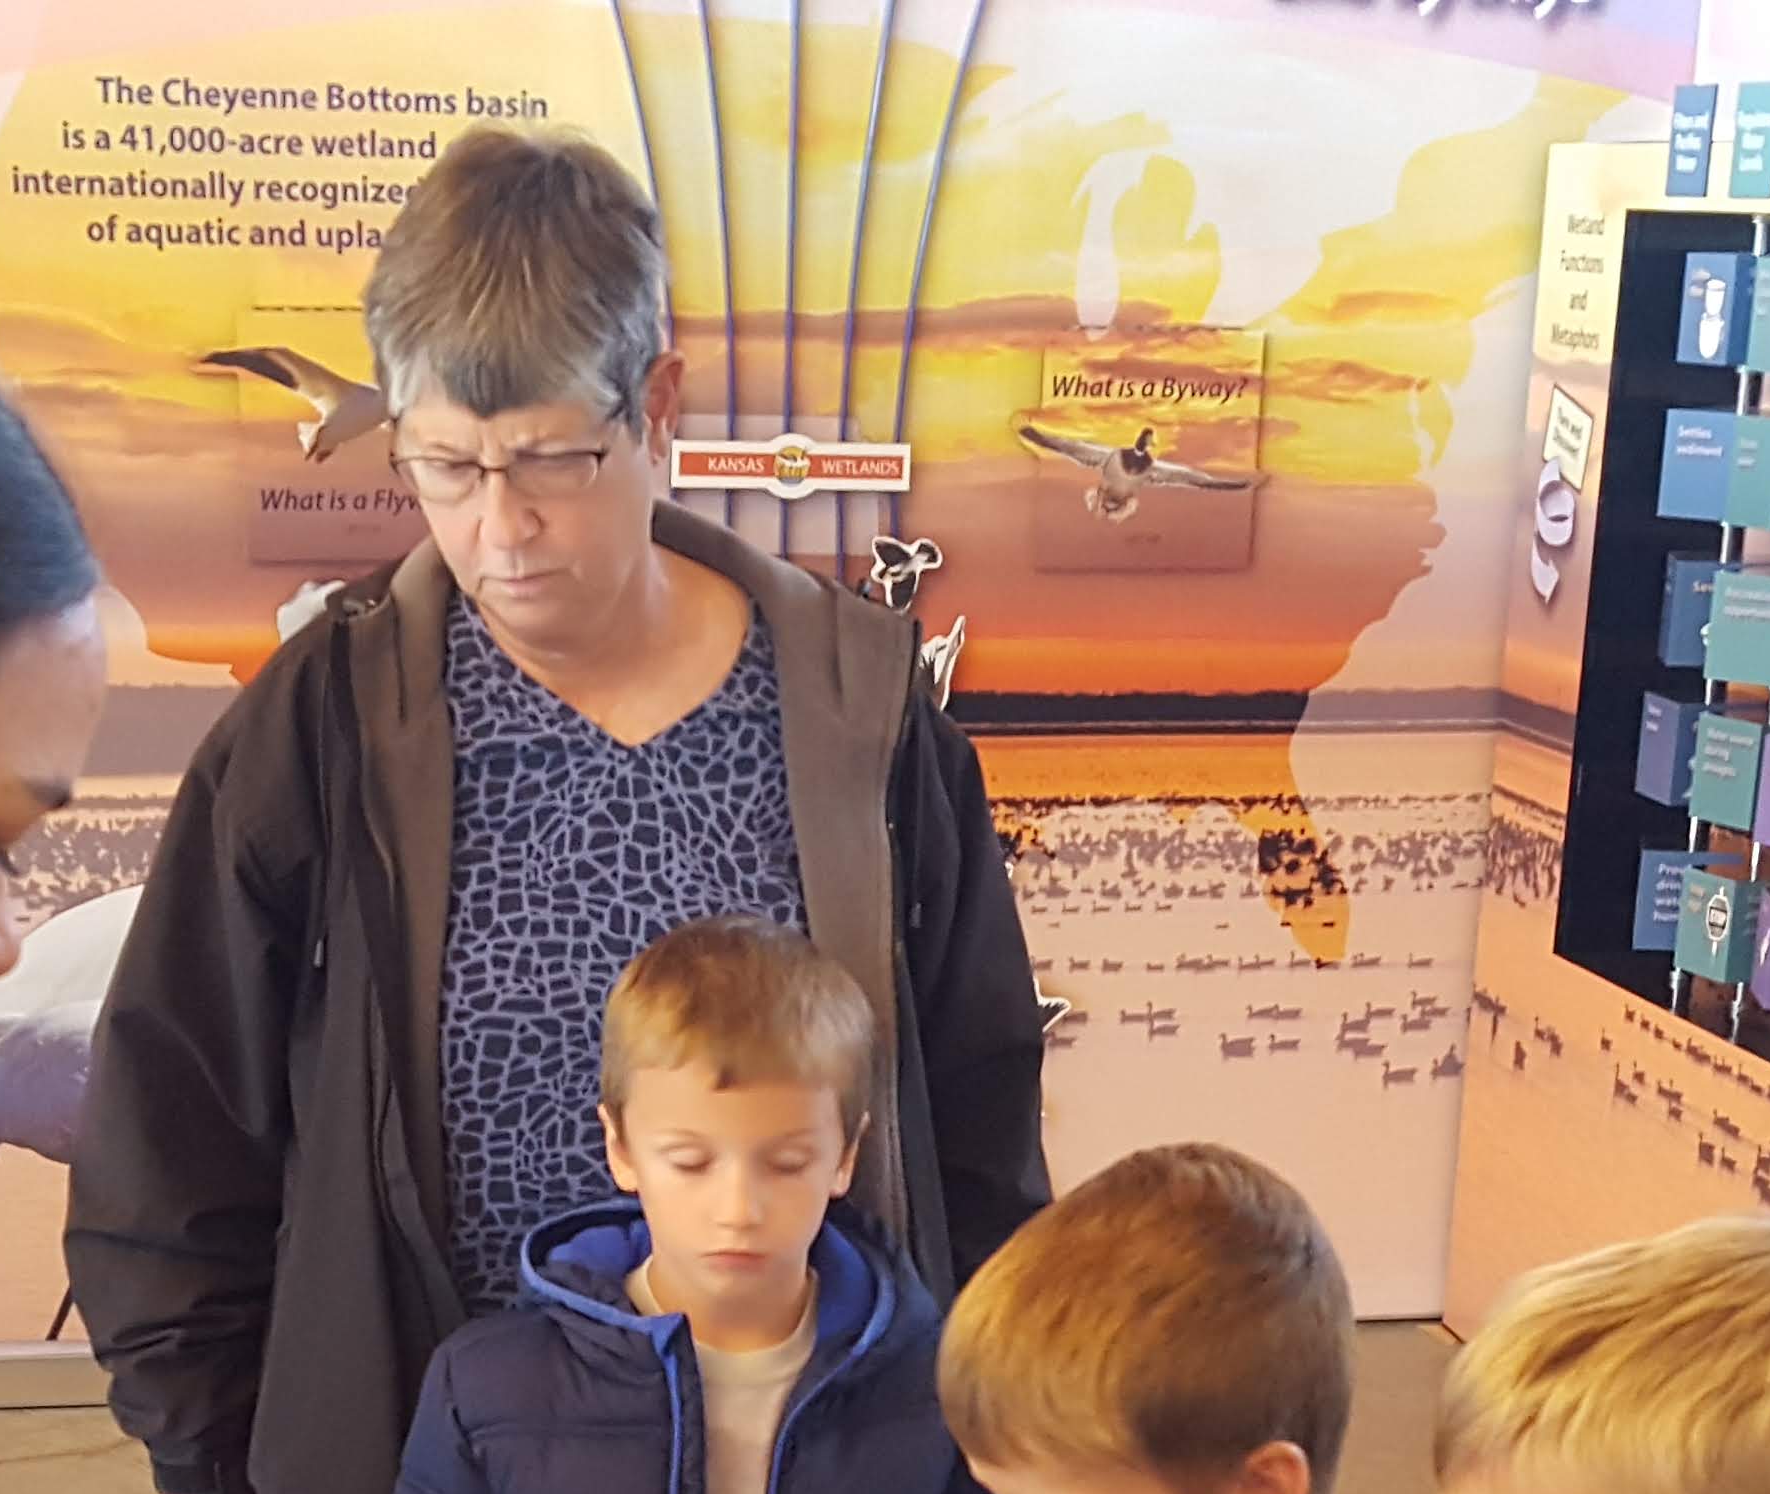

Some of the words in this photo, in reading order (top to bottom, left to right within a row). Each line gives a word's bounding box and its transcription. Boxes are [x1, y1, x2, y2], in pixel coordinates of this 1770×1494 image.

[95, 77, 153, 106] The
[162, 79, 317, 115] Cheyenne
[326, 85, 457, 114] Bottoms
[467, 88, 549, 118] basin
[63, 122, 86, 149] is
[94, 131, 111, 151] a
[119, 125, 303, 157] 41,000-acre
[312, 131, 437, 159] wetland
[12, 166, 244, 206] internationally
[87, 214, 118, 242] of
[126, 218, 240, 250] aquatic
[249, 218, 306, 247] and
[316, 223, 382, 255] upla
[1053, 375, 1111, 398] What
[1118, 376, 1134, 398] is
[1141, 382, 1155, 398] a
[1161, 376, 1248, 405] Byway?
[707, 456, 765, 475] KANSAS
[819, 458, 900, 476] WETLANDS
[260, 488, 325, 511] What
[329, 488, 347, 511] is
[351, 493, 369, 511] a
